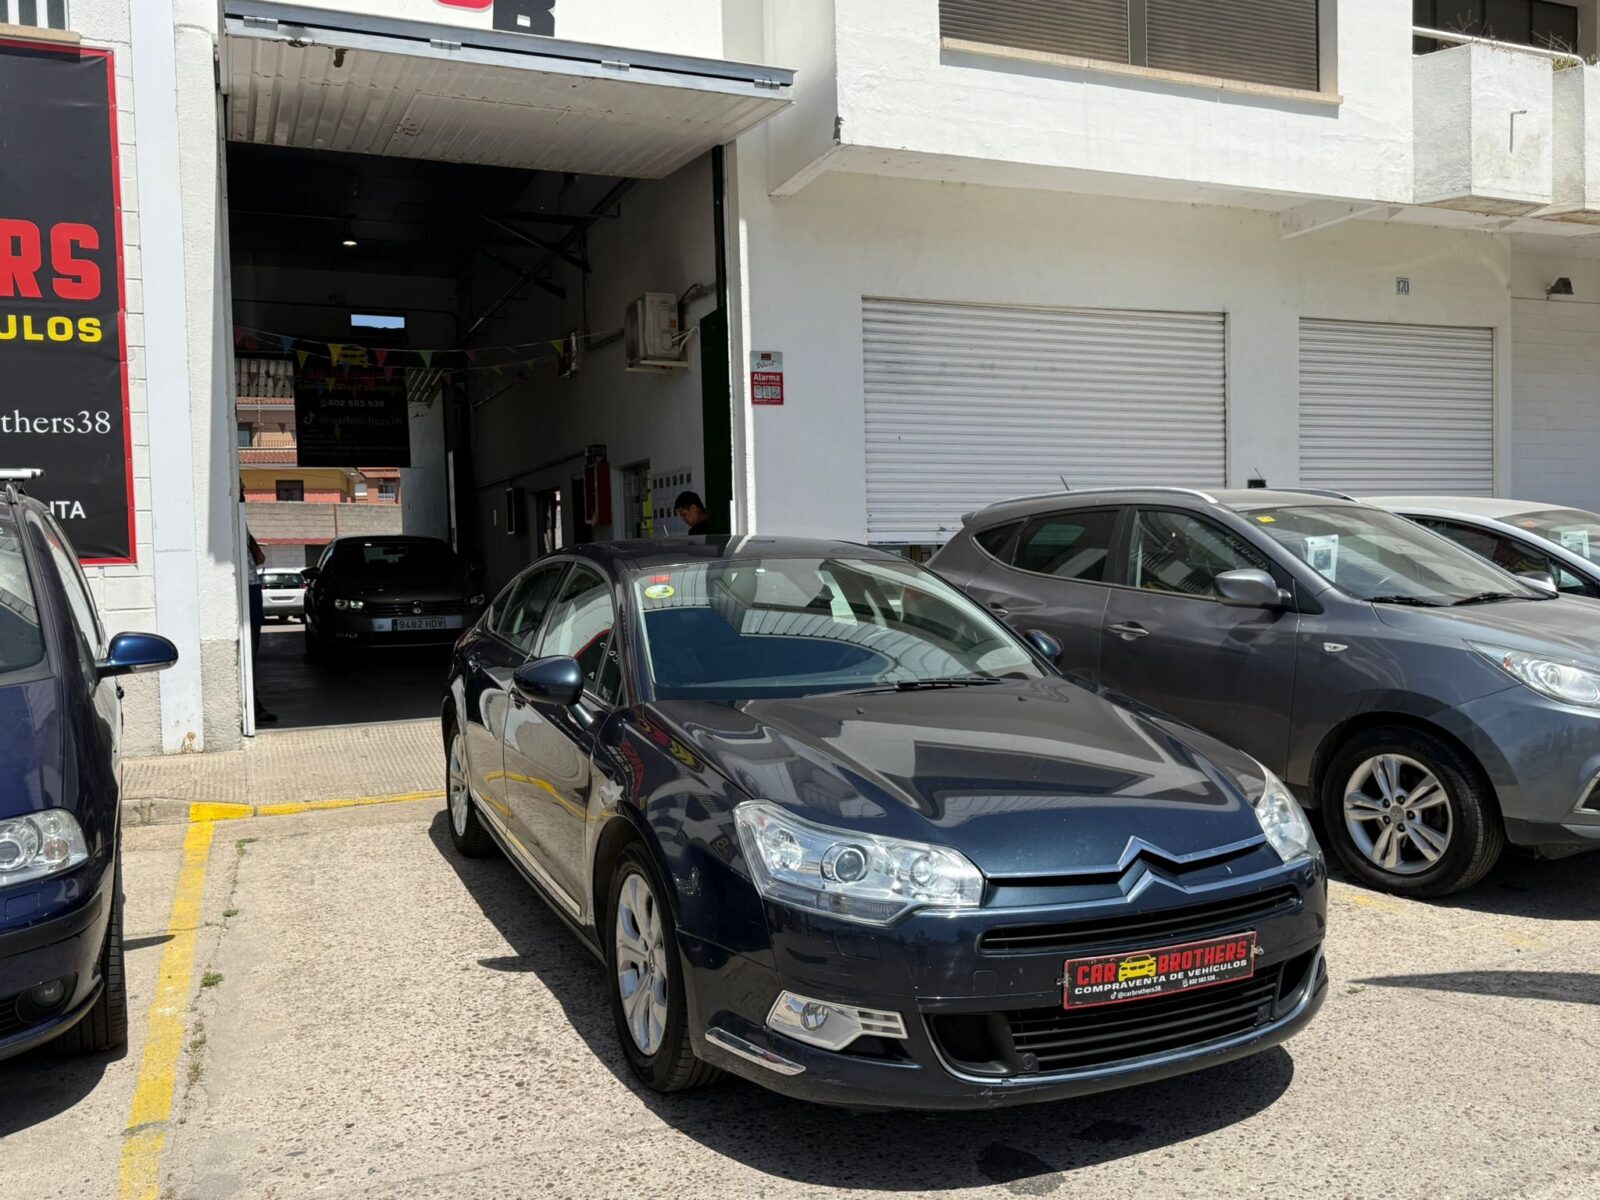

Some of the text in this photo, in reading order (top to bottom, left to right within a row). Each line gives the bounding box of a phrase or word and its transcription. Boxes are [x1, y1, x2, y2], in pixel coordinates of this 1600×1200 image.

[753, 373, 780, 382] Alarma
[0, 410, 112, 434] thers38
[1077, 941, 1248, 985] CAR BROTHERS
[1074, 975, 1167, 995] COMPRAVENTA
[1169, 971, 1185, 981] DE
